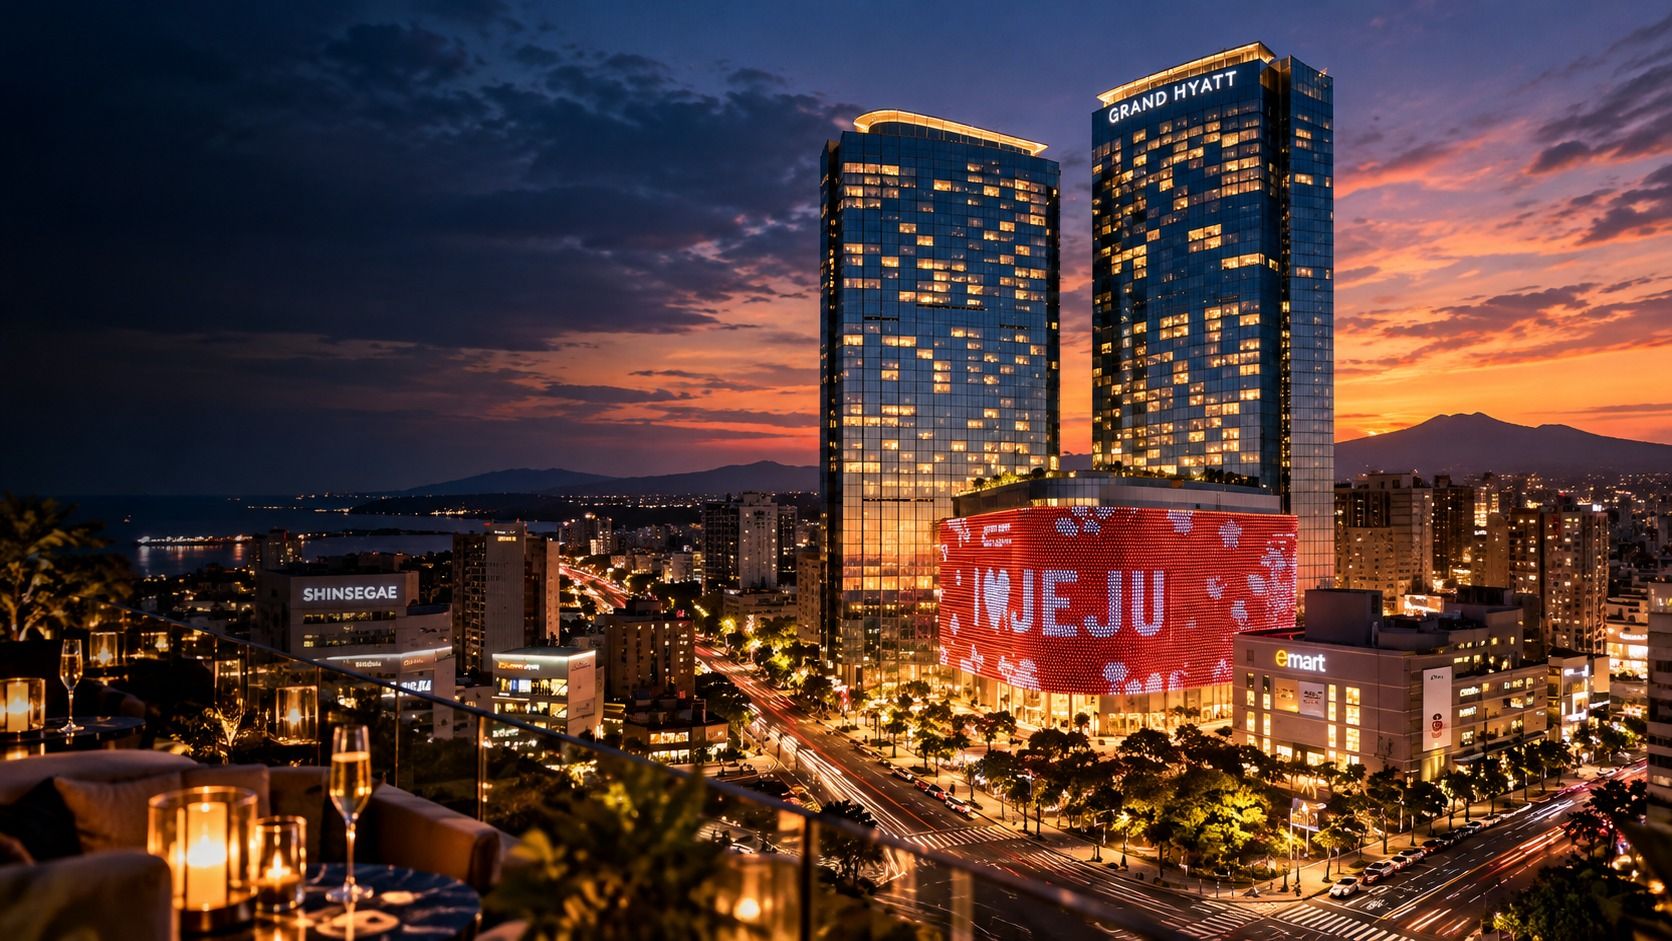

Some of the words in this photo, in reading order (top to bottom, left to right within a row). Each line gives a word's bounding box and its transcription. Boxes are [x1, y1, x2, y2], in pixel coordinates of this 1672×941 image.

[1108, 91, 1167, 123] GRAND
[1174, 70, 1237, 101] HYATT
[303, 585, 398, 601] SHINSEGAE
[973, 567, 980, 627] I
[1010, 568, 1165, 638] JEJU
[1275, 649, 1327, 673] emart
